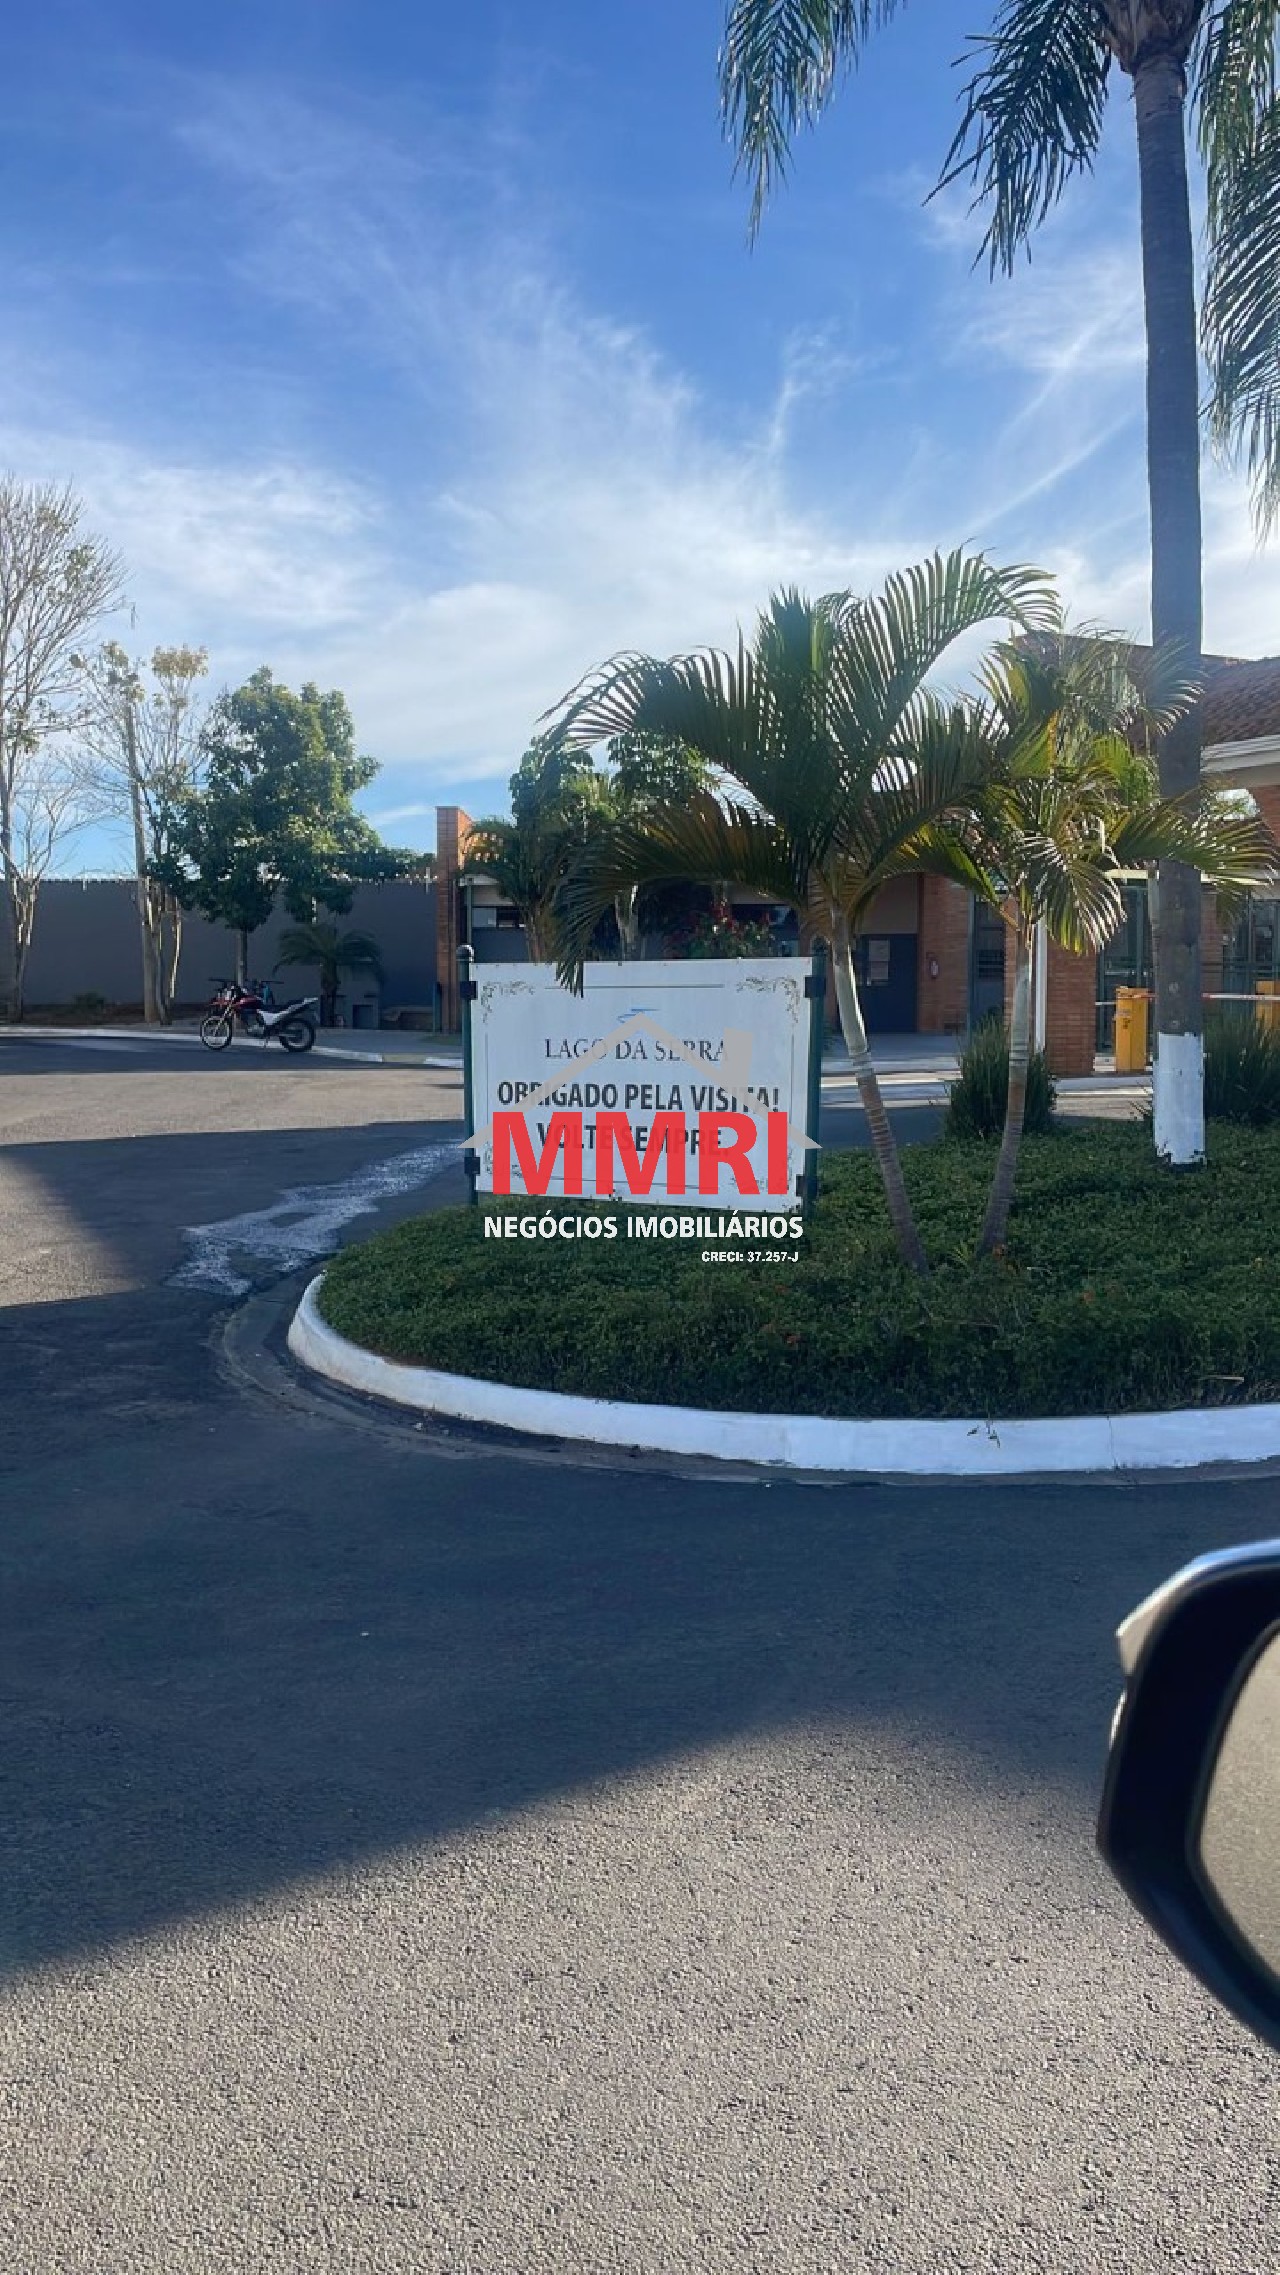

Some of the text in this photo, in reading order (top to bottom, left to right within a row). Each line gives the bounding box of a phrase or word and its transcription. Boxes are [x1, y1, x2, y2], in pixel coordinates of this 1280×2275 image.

[544, 1038, 607, 1060] LAGO
[615, 1038, 648, 1060] DA
[624, 1083, 683, 1110] PELA
